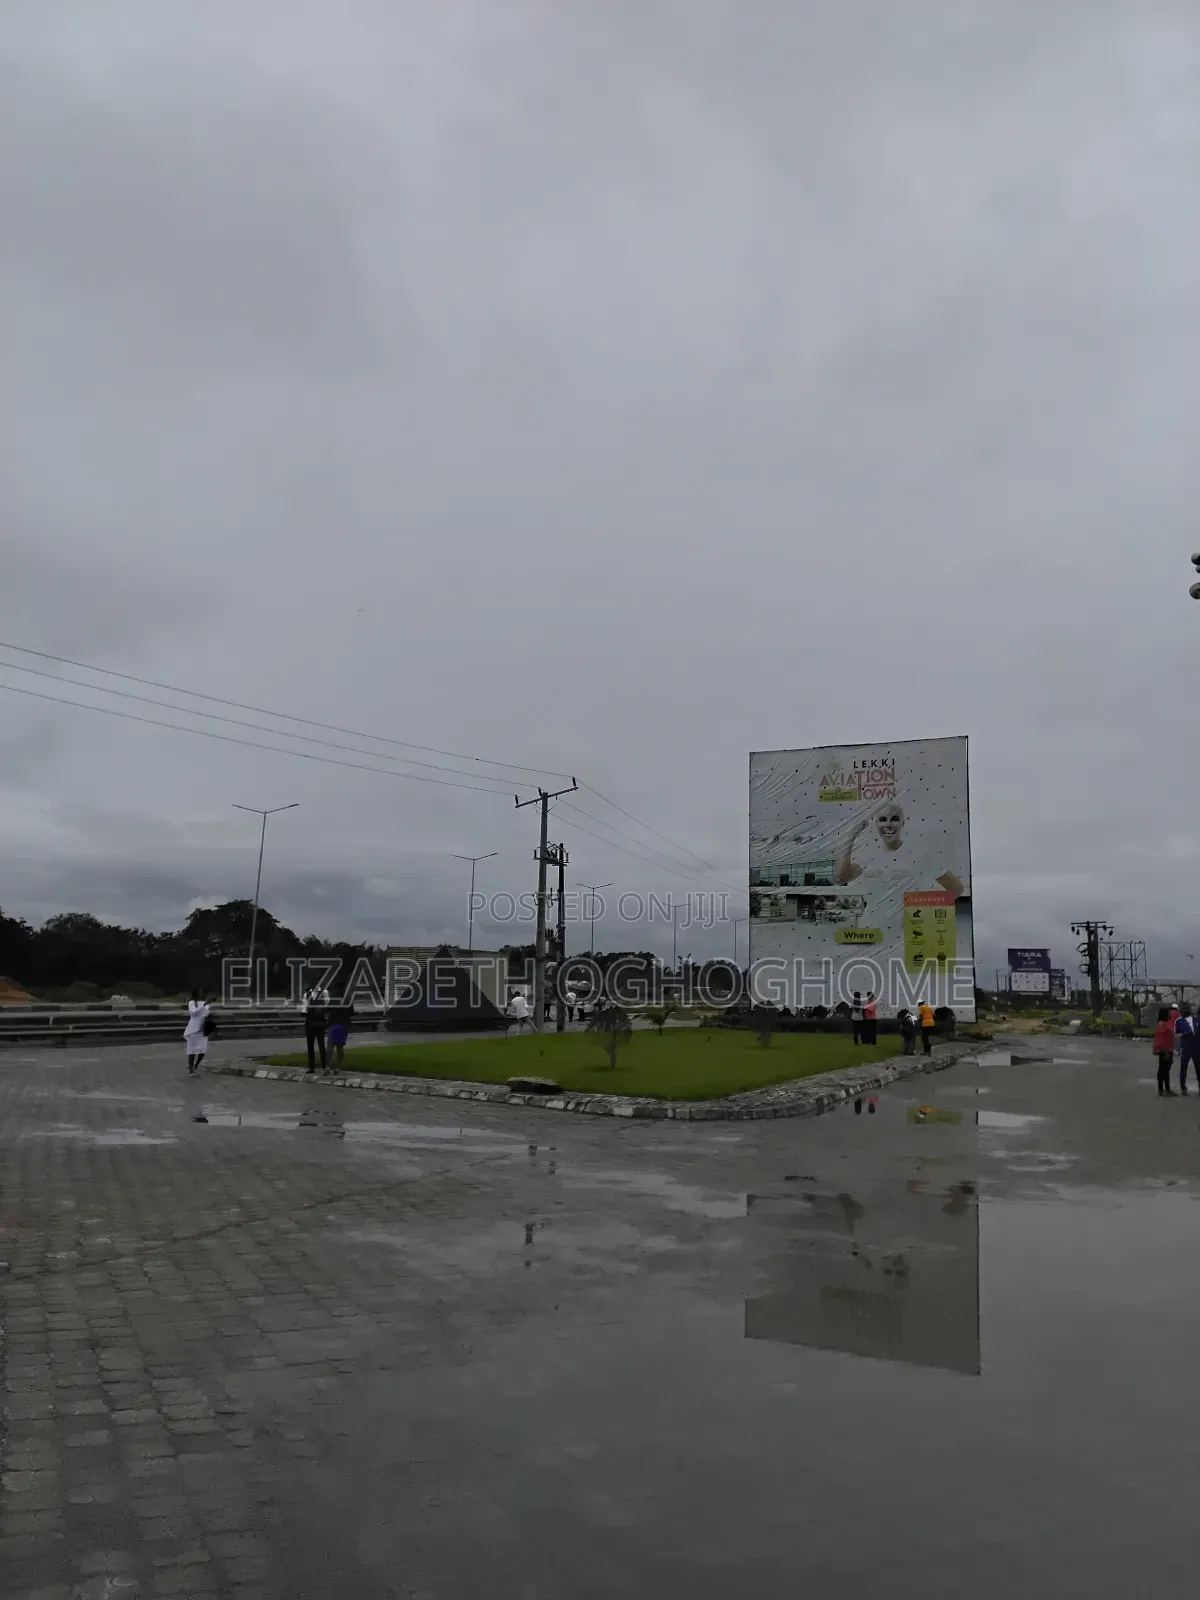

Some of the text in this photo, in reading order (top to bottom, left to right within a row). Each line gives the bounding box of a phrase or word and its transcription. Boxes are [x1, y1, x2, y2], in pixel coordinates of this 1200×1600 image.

[853, 758, 895, 768] LEKKI
[820, 767, 895, 788] AVIATION
[844, 931, 874, 940] Where
